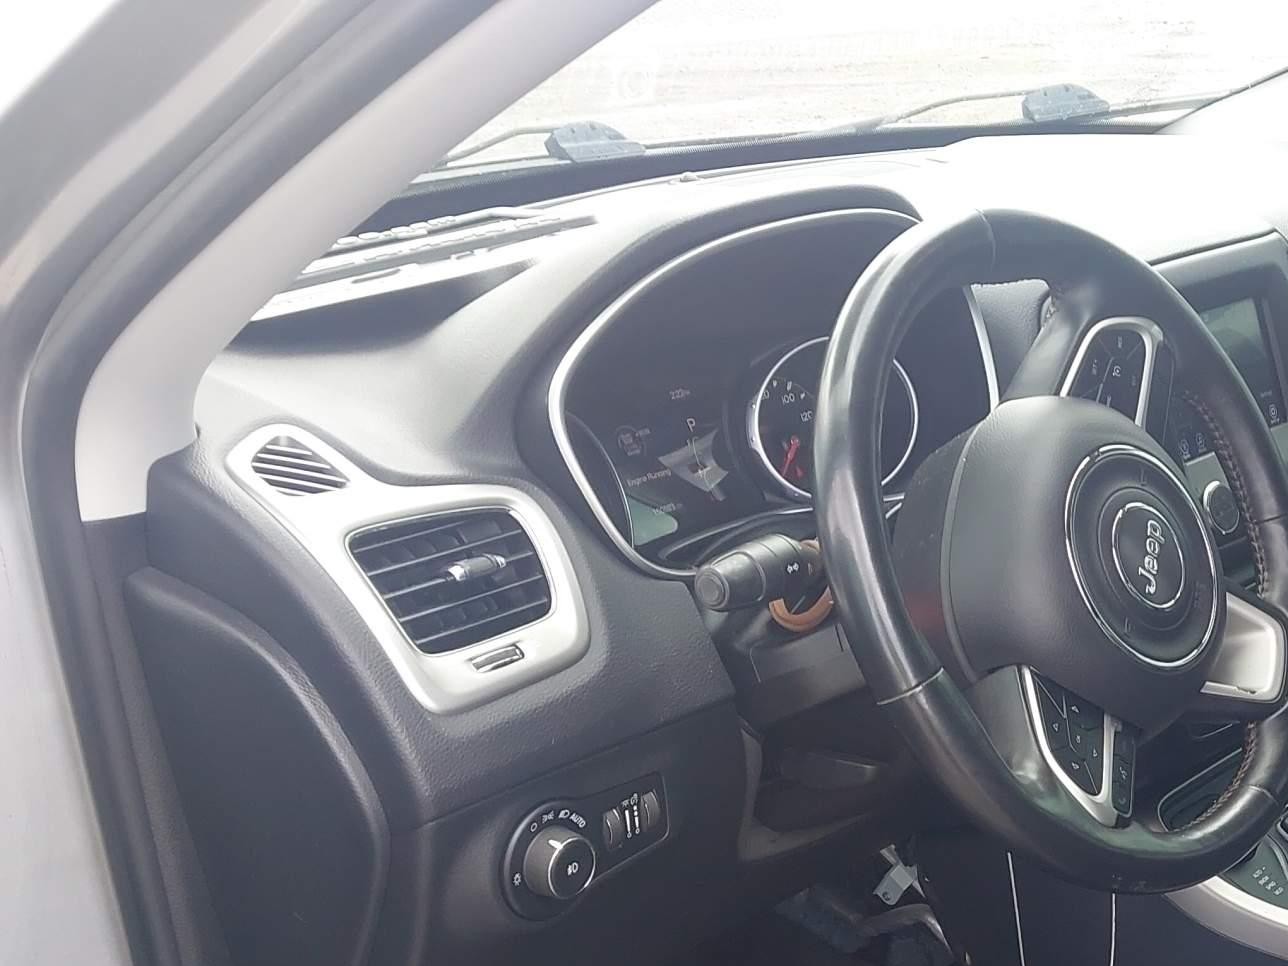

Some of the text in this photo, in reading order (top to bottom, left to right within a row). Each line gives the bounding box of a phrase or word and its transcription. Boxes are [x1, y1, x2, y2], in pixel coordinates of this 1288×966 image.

[781, 392, 795, 406] 100
[686, 417, 696, 432] P
[1138, 519, 1166, 595] Jeep
[569, 812, 586, 828] AUTO
